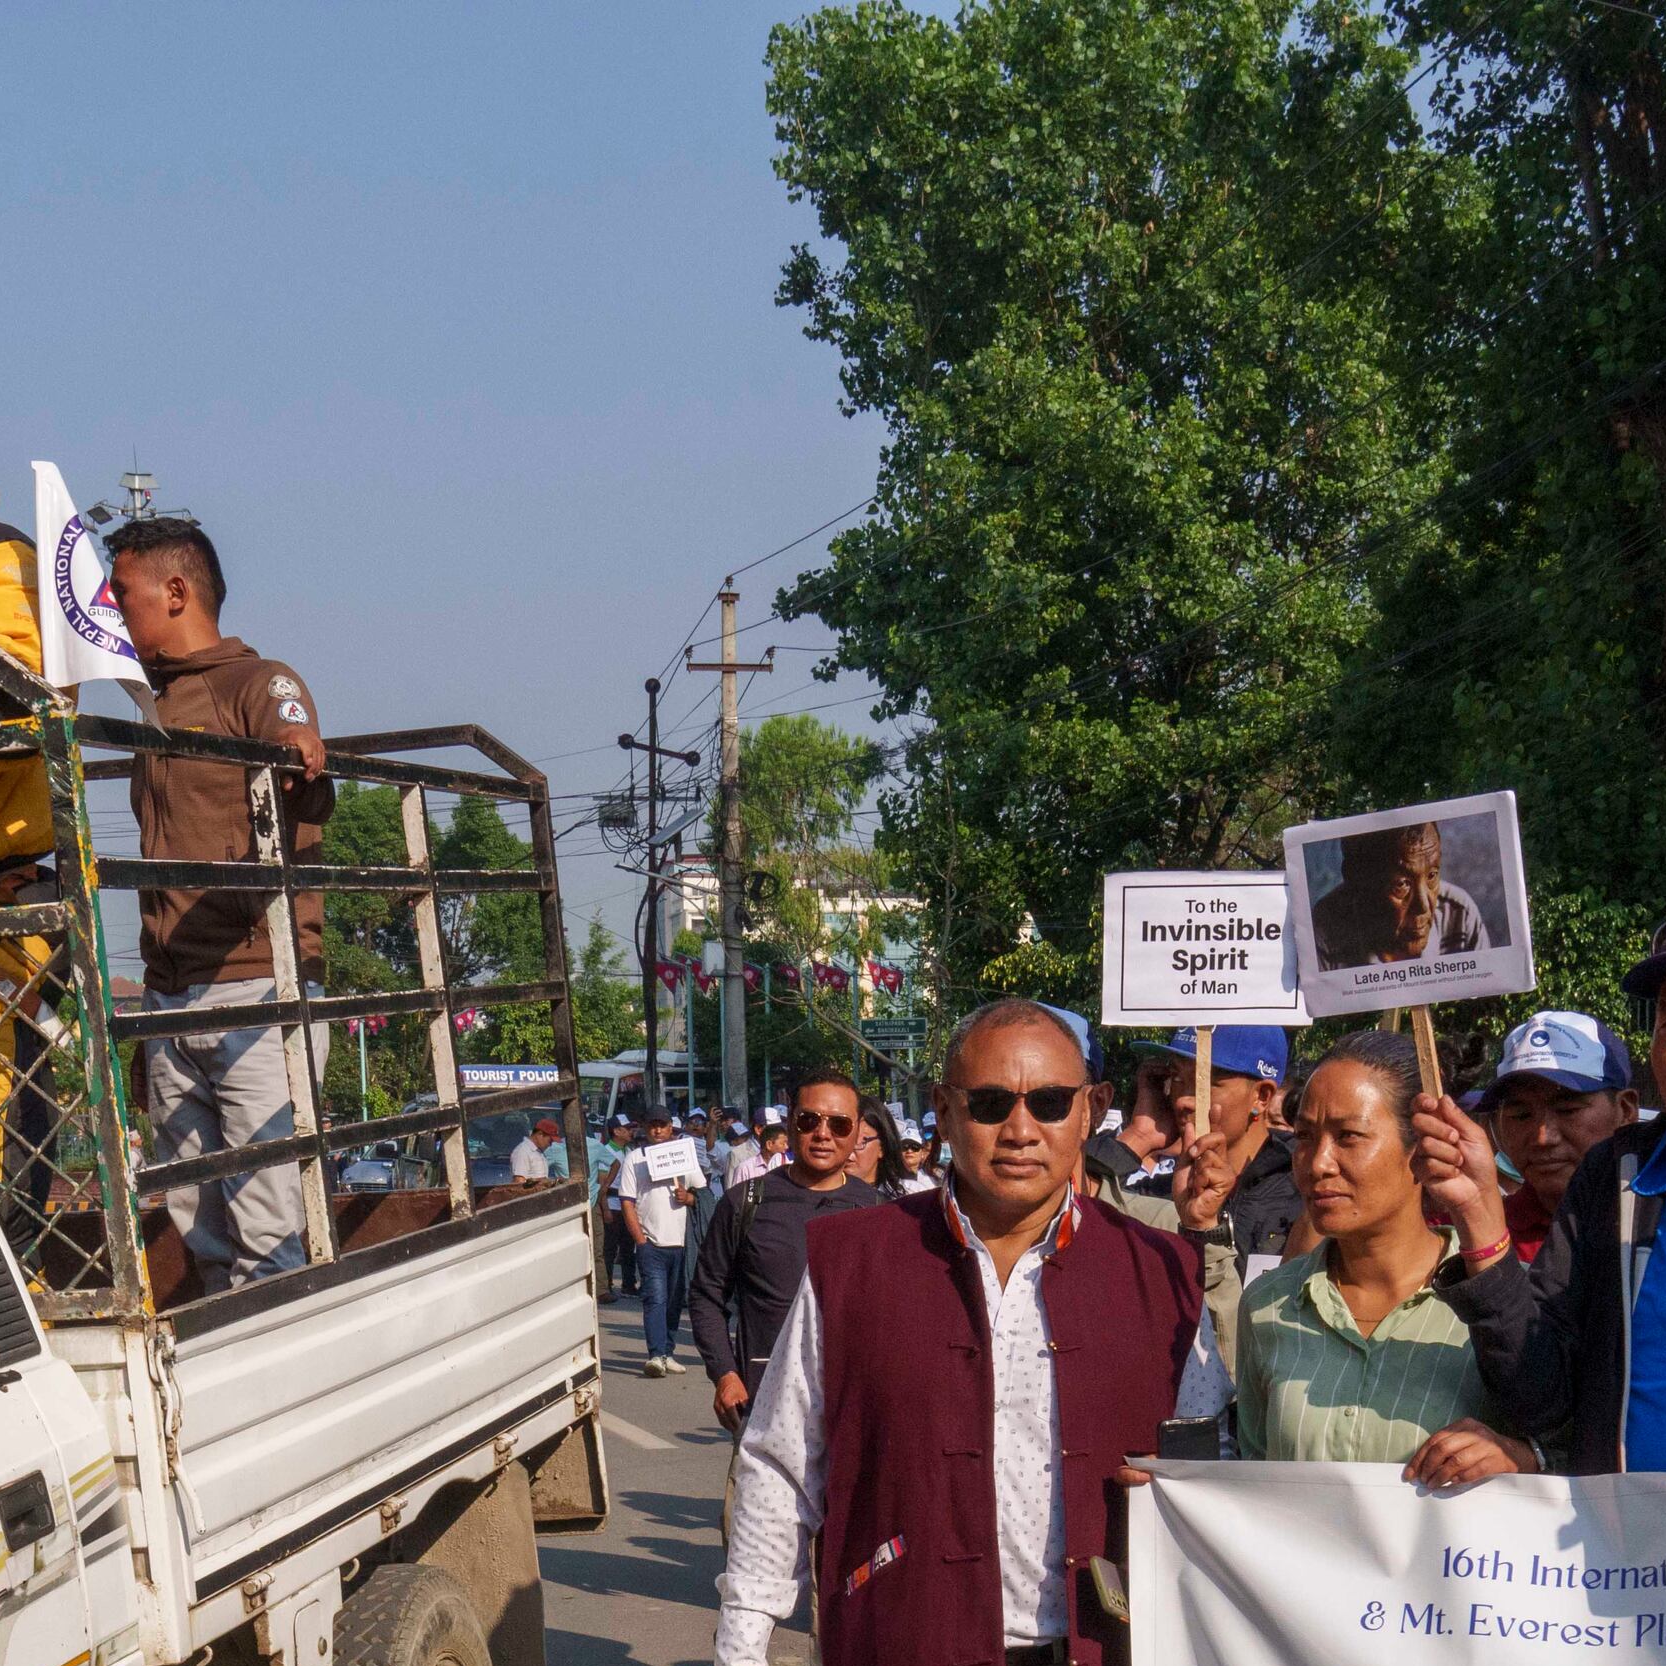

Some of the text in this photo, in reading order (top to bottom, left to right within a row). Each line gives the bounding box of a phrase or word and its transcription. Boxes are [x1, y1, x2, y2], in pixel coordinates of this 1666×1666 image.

[55, 524, 122, 653] NEPAL NATIONAL
[1185, 898, 1237, 914] To the
[1141, 917, 1281, 942] Invinsible
[1171, 947, 1249, 976] Spirit
[1354, 958, 1477, 985] Late Ang Rita Sherpa
[1180, 979, 1238, 994] of Man
[463, 1069, 560, 1082] TOURIST POLICE
[1442, 1546, 1513, 1582] 16th
[1359, 1600, 1386, 1632] &
[1400, 1602, 1453, 1635] Mt.
[1468, 1603, 1620, 1647] Everest
